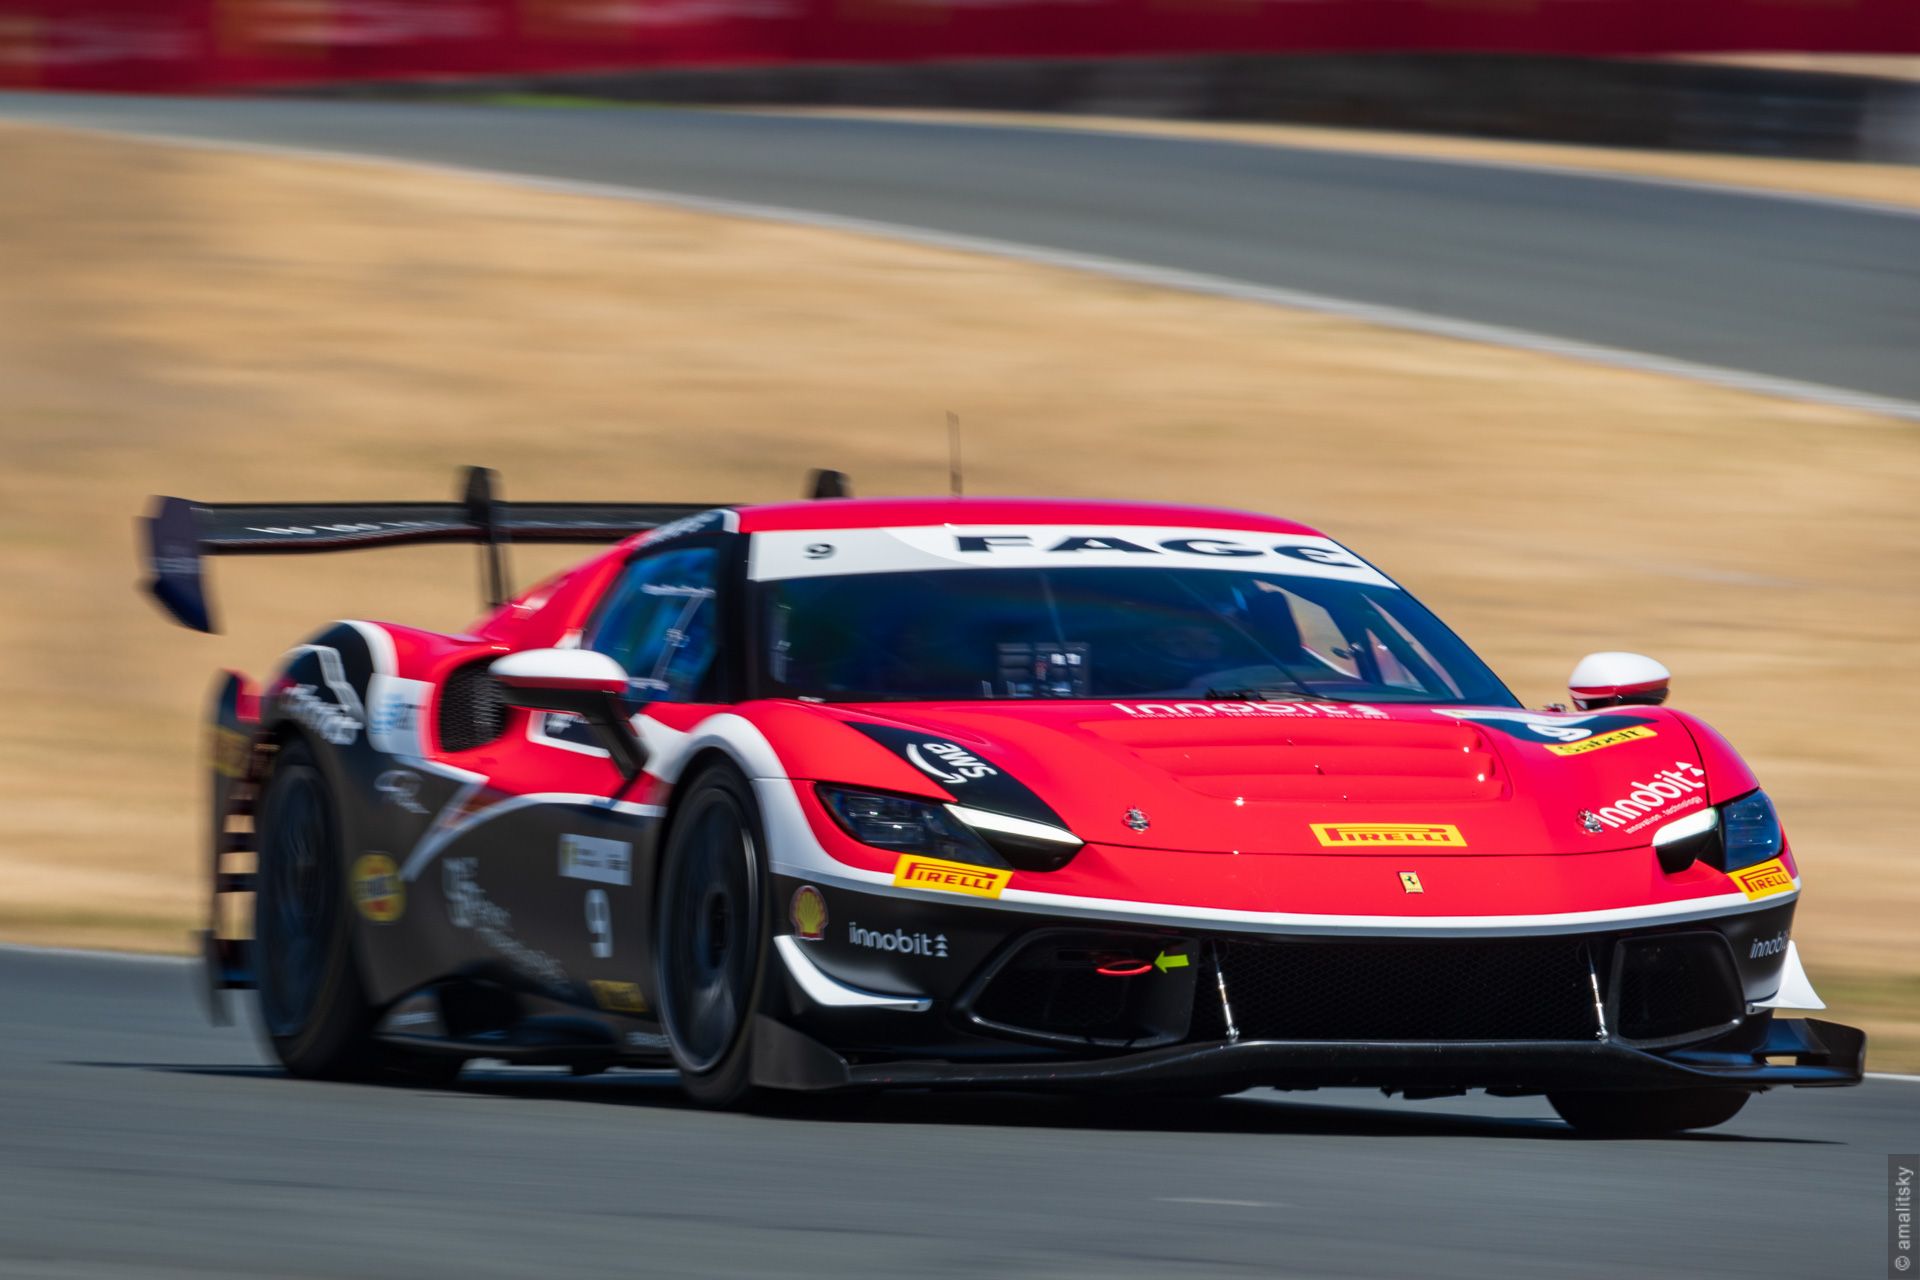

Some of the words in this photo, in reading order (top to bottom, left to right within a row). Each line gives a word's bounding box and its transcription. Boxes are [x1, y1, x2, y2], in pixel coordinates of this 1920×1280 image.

[802, 543, 836, 560] 9
[1110, 701, 1347, 716] innobit
[922, 743, 998, 778] aws
[1592, 769, 1705, 828] innobit
[1324, 827, 1451, 841] PIRELLI
[905, 862, 999, 890] PIRELLI
[1739, 866, 1789, 893] PIRELLI
[584, 889, 613, 958] 9
[849, 921, 932, 955] innobit
